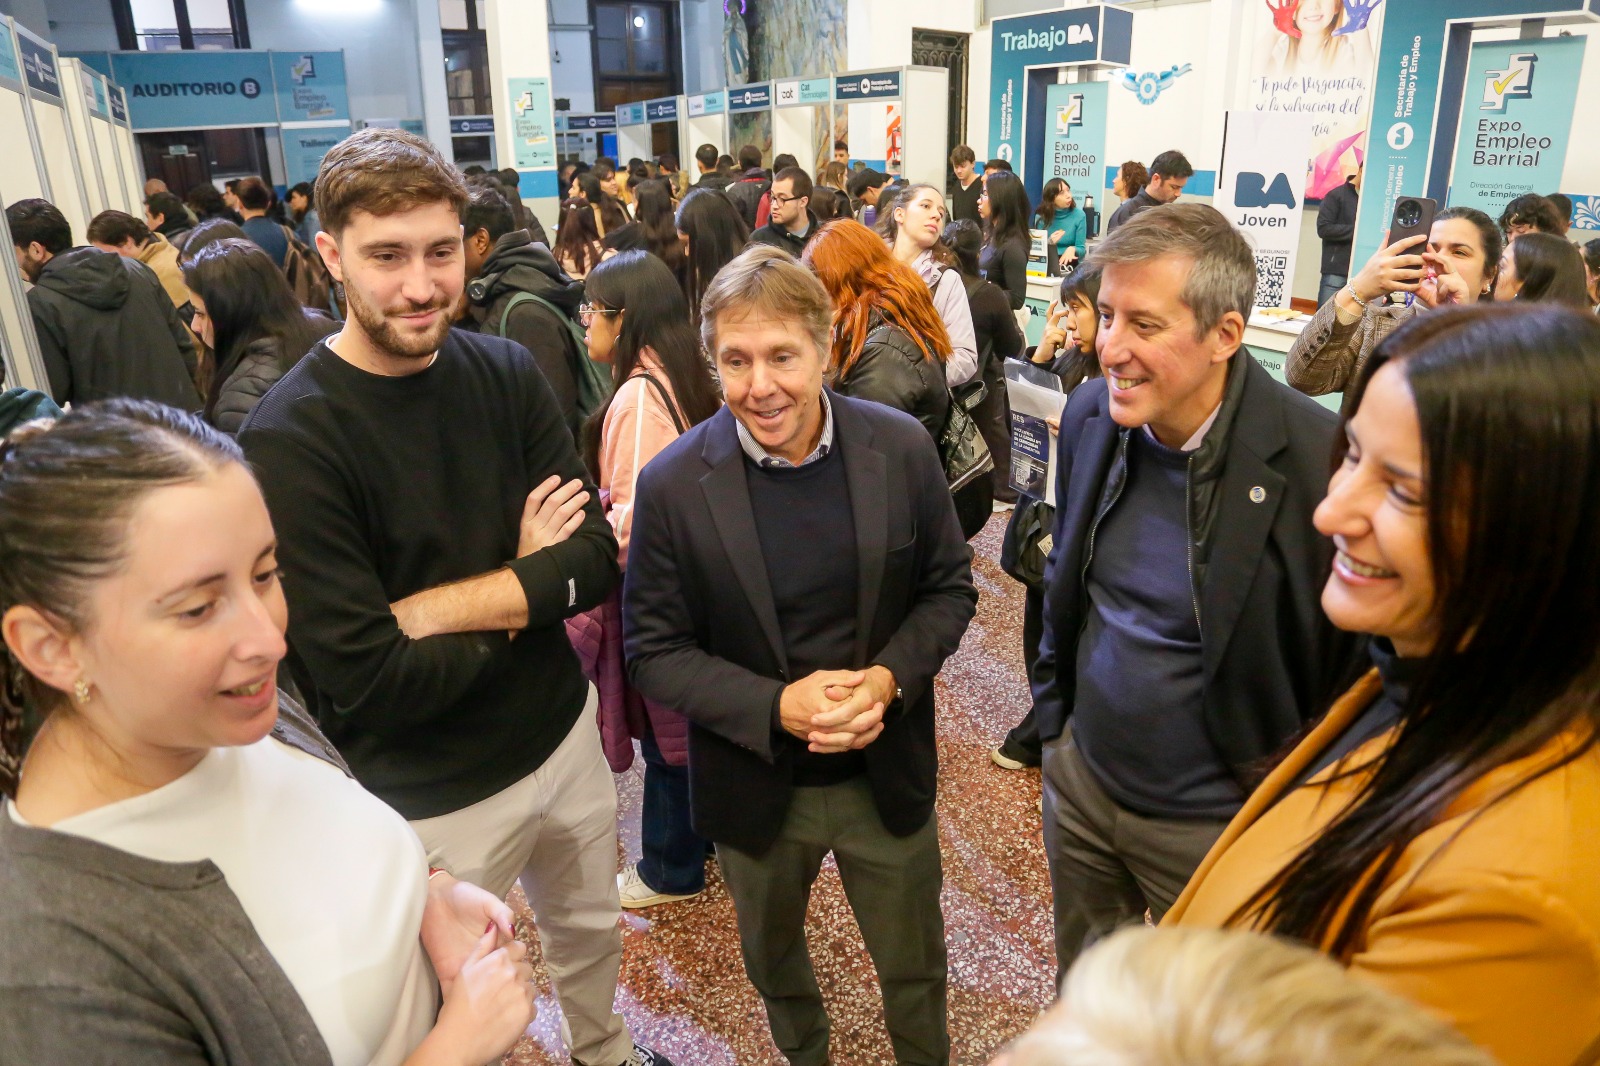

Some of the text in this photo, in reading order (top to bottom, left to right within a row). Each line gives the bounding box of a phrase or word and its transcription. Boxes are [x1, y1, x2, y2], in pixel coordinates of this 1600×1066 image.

[1001, 23, 1094, 51] Trabajo BA
[1400, 55, 1409, 68] de
[1409, 35, 1421, 73] Empleo
[132, 82, 236, 97] AUDITORIO
[1001, 93, 1007, 103] de
[1340, 95, 1363, 115] del
[1403, 81, 1417, 118] Trabajo
[516, 124, 542, 132] Empleo
[1478, 118, 1522, 134] Expo
[1394, 126, 1406, 145] BA
[1475, 133, 1552, 152] Empleo
[1054, 141, 1079, 151] Expo
[1054, 152, 1096, 167] Empleo
[1472, 150, 1541, 167] Barrial
[1053, 165, 1090, 177] Barrial
[1385, 164, 1396, 195] General
[1393, 165, 1404, 200] Empleo
[1470, 181, 1534, 191] Dirección General
[1234, 171, 1297, 210] BA
[1490, 190, 1522, 199] Empleo
[1237, 213, 1287, 228] Joven
[1258, 358, 1281, 370] abajo
[1012, 413, 1025, 424] RES
